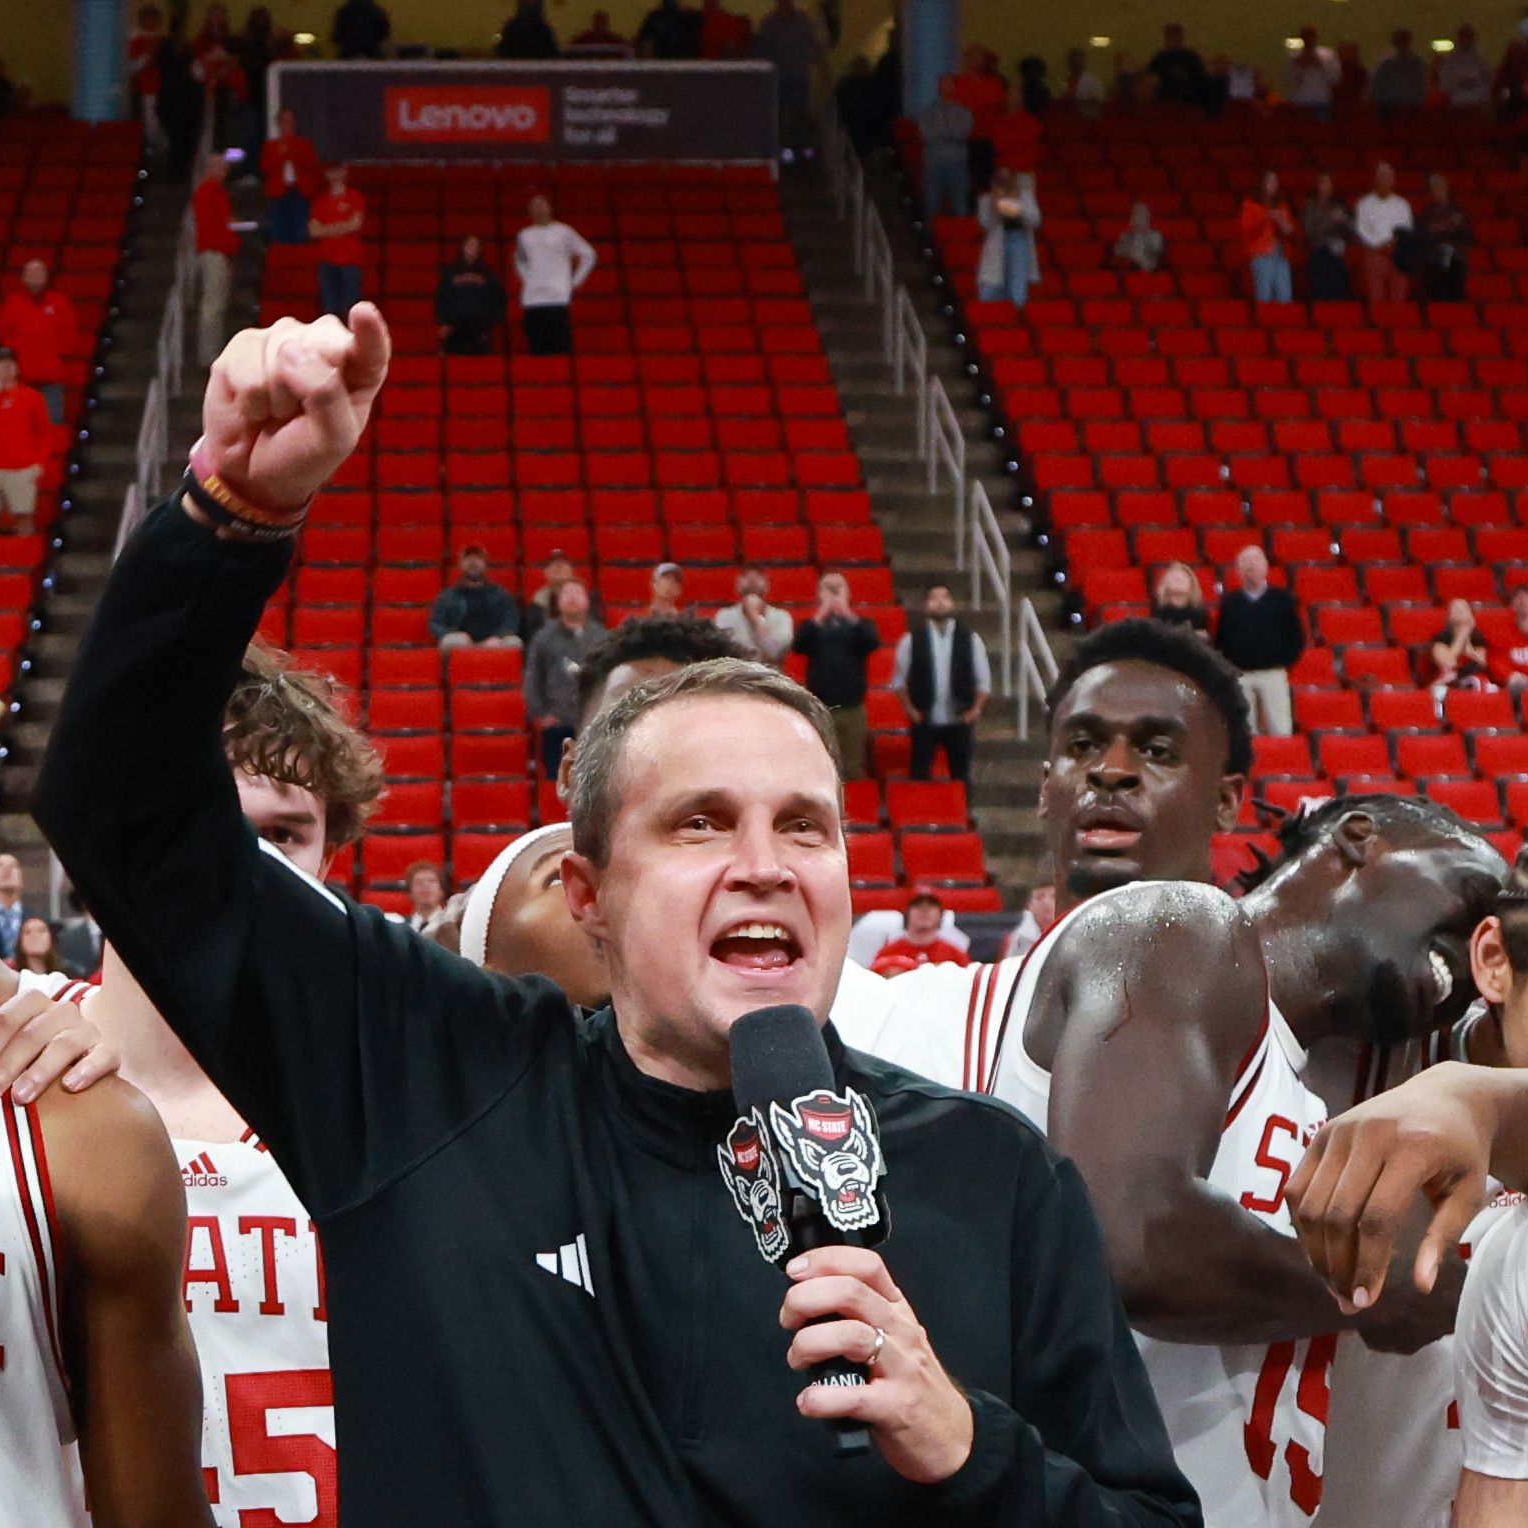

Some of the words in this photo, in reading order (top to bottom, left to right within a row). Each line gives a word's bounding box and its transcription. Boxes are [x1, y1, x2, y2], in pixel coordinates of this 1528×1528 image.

[399, 99, 537, 131] Lenovo
[822, 1119, 847, 1134] STATE
[182, 1172, 228, 1188] didas
[1489, 1194, 1528, 1209] adid
